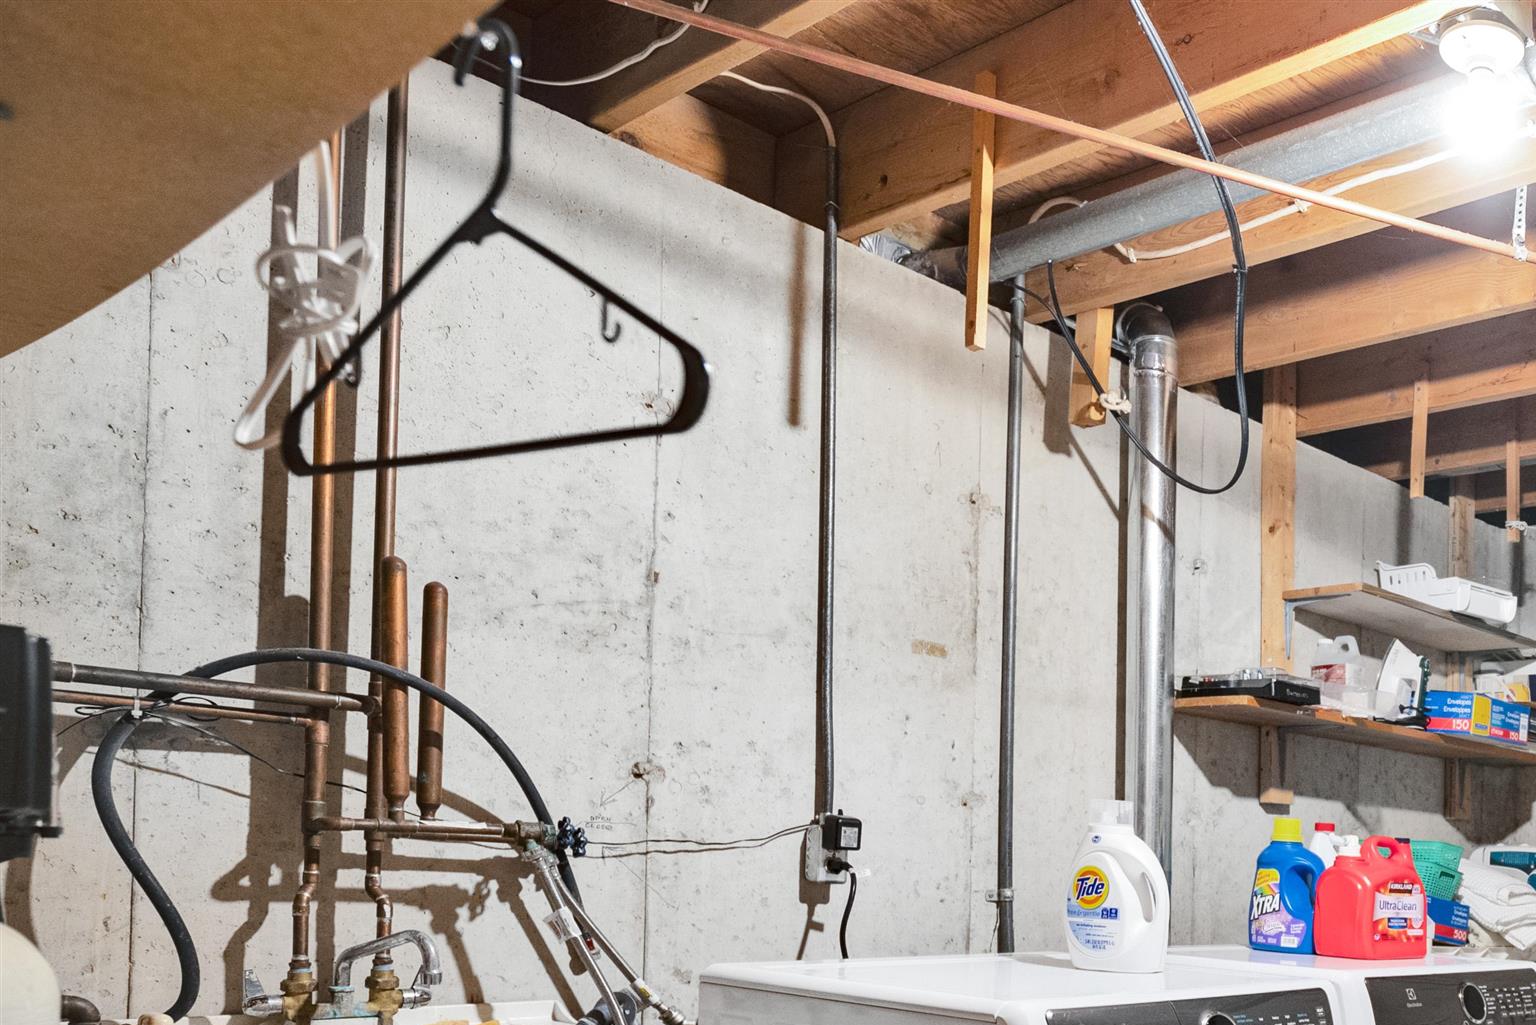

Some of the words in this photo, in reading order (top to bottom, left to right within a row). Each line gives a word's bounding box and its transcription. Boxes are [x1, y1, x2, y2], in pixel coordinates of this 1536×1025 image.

[1452, 719, 1470, 730] 150
[1509, 731, 1519, 741] 150
[1076, 876, 1105, 900] Tide
[1250, 893, 1280, 920] XTRA
[1453, 929, 1467, 940] 500
